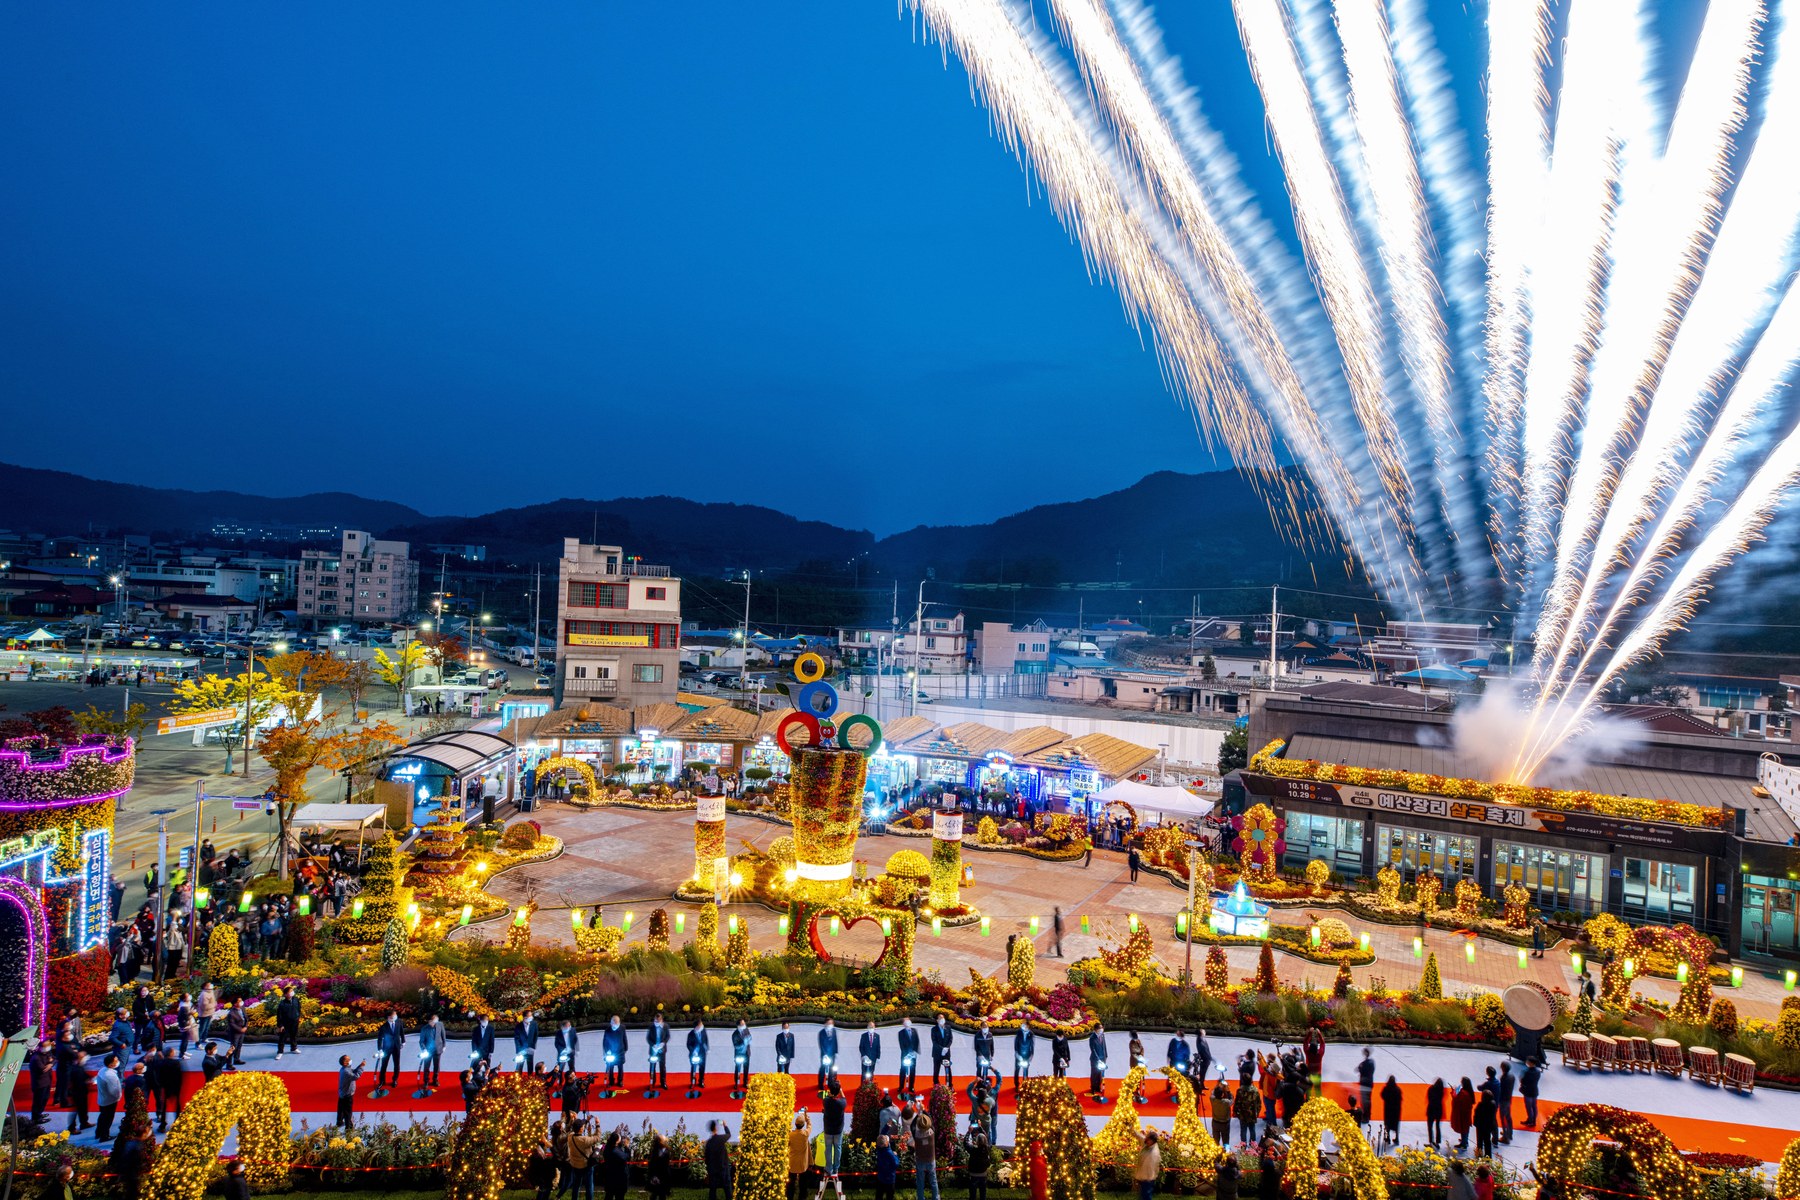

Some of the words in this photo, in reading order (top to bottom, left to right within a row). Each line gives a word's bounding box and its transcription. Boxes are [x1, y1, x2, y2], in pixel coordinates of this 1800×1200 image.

[1288, 782, 1310, 791] 10.16
[1288, 790, 1310, 799] 10.29
[1378, 792, 1447, 816] 예산장터
[1450, 801, 1524, 826] 삼국축제
[91, 835, 102, 874] 삼국의
[90, 874, 102, 901] 향연
